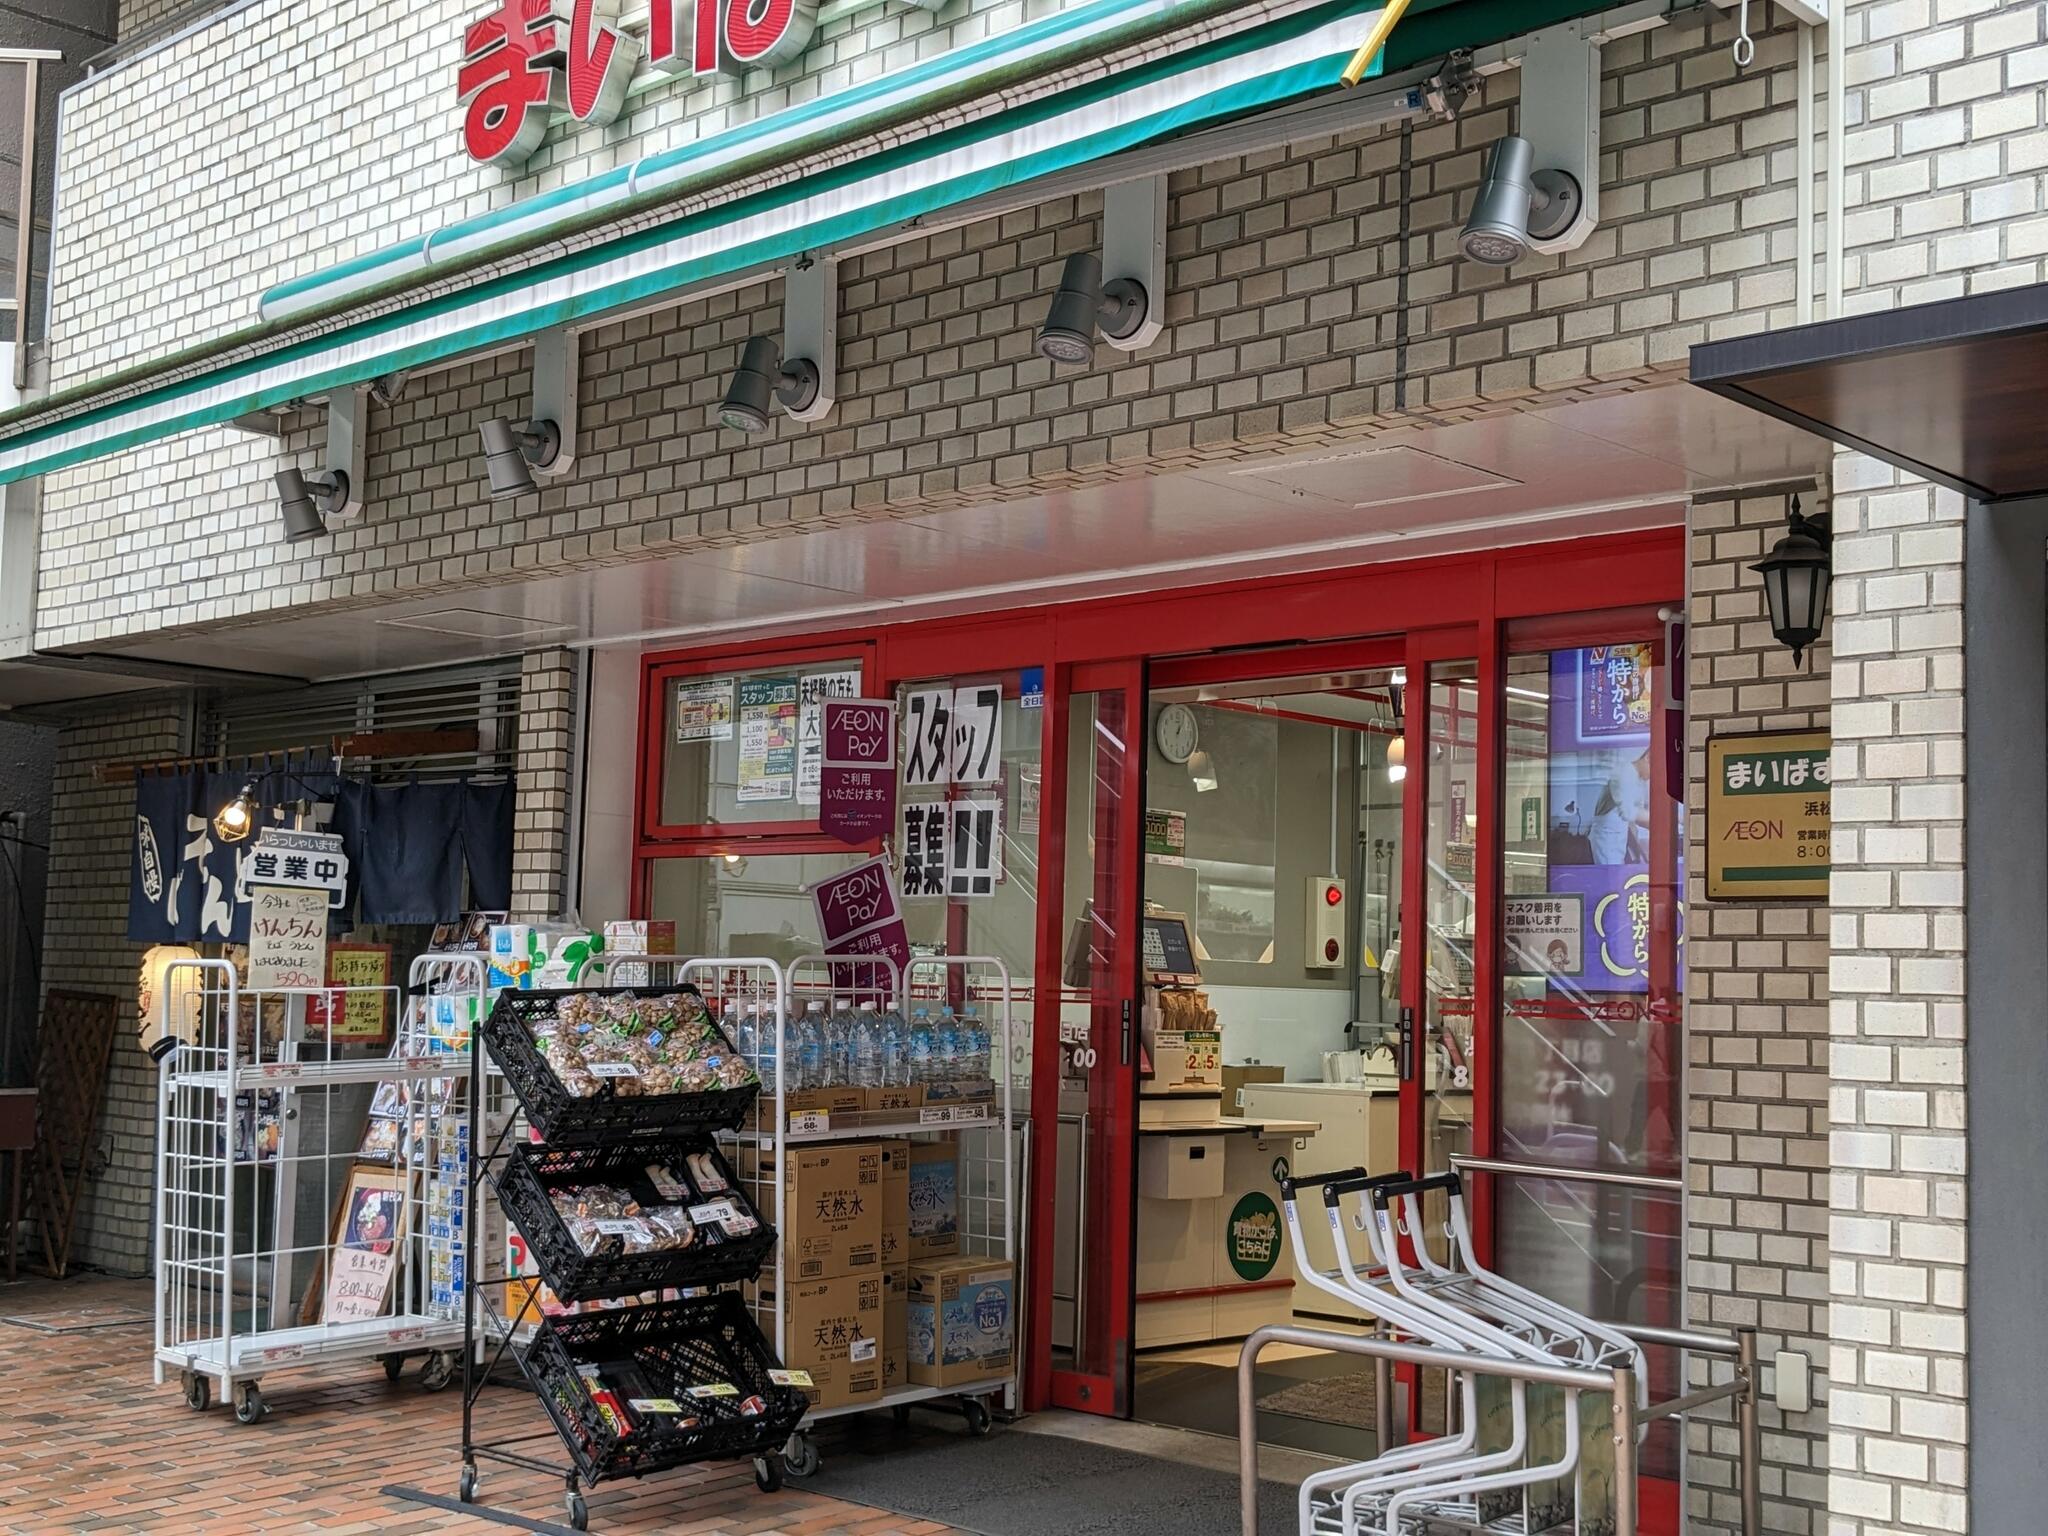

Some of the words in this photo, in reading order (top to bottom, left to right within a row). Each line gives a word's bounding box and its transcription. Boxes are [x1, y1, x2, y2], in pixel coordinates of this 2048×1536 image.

[1607, 658, 1632, 725] 特から
[906, 689, 1000, 782] スタッフ
[841, 773, 871, 785] ご利用
[827, 788, 886, 802] いただけます。
[259, 835, 339, 851] いらっしゃいませ
[1797, 829, 1831, 841] 営業時
[254, 852, 339, 883] 営業中
[1505, 902, 1562, 914] マスク着用を
[254, 917, 323, 938] けんちん
[1505, 914, 1562, 926] お願いします
[848, 932, 883, 955] ご利用
[816, 1195, 864, 1219] 天然水
[979, 1312, 1002, 1328] No.1
[814, 1322, 864, 1347] 天然水
